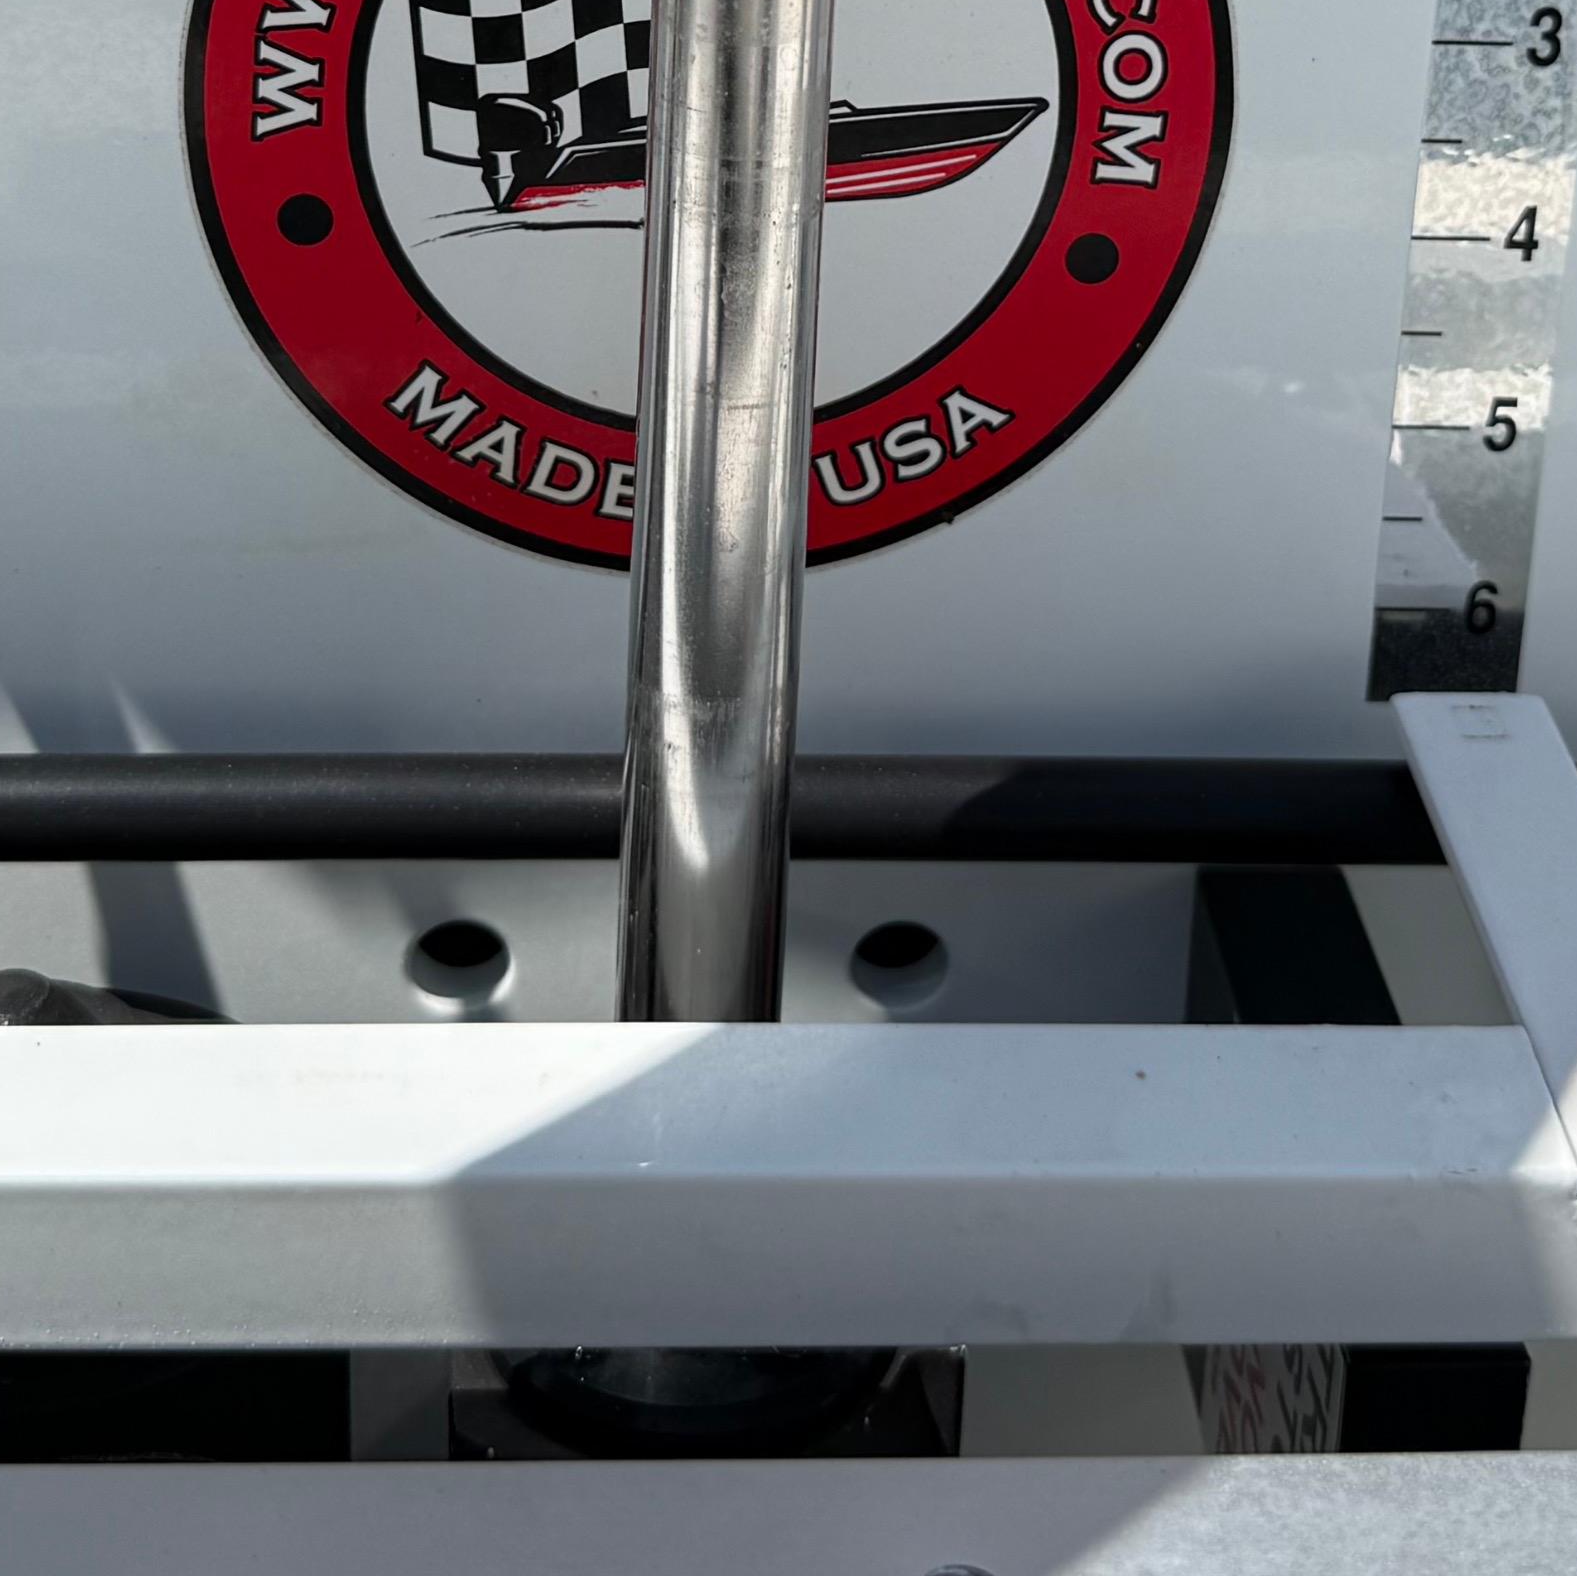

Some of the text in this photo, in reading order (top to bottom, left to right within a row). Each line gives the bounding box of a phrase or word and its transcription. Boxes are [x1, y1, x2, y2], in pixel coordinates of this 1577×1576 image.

[1525, 6, 1564, 67] 3
[1502, 204, 1540, 262] 4
[387, 360, 1016, 523] MADE USA
[1481, 396, 1519, 452] 5
[1463, 579, 1499, 635] 6
